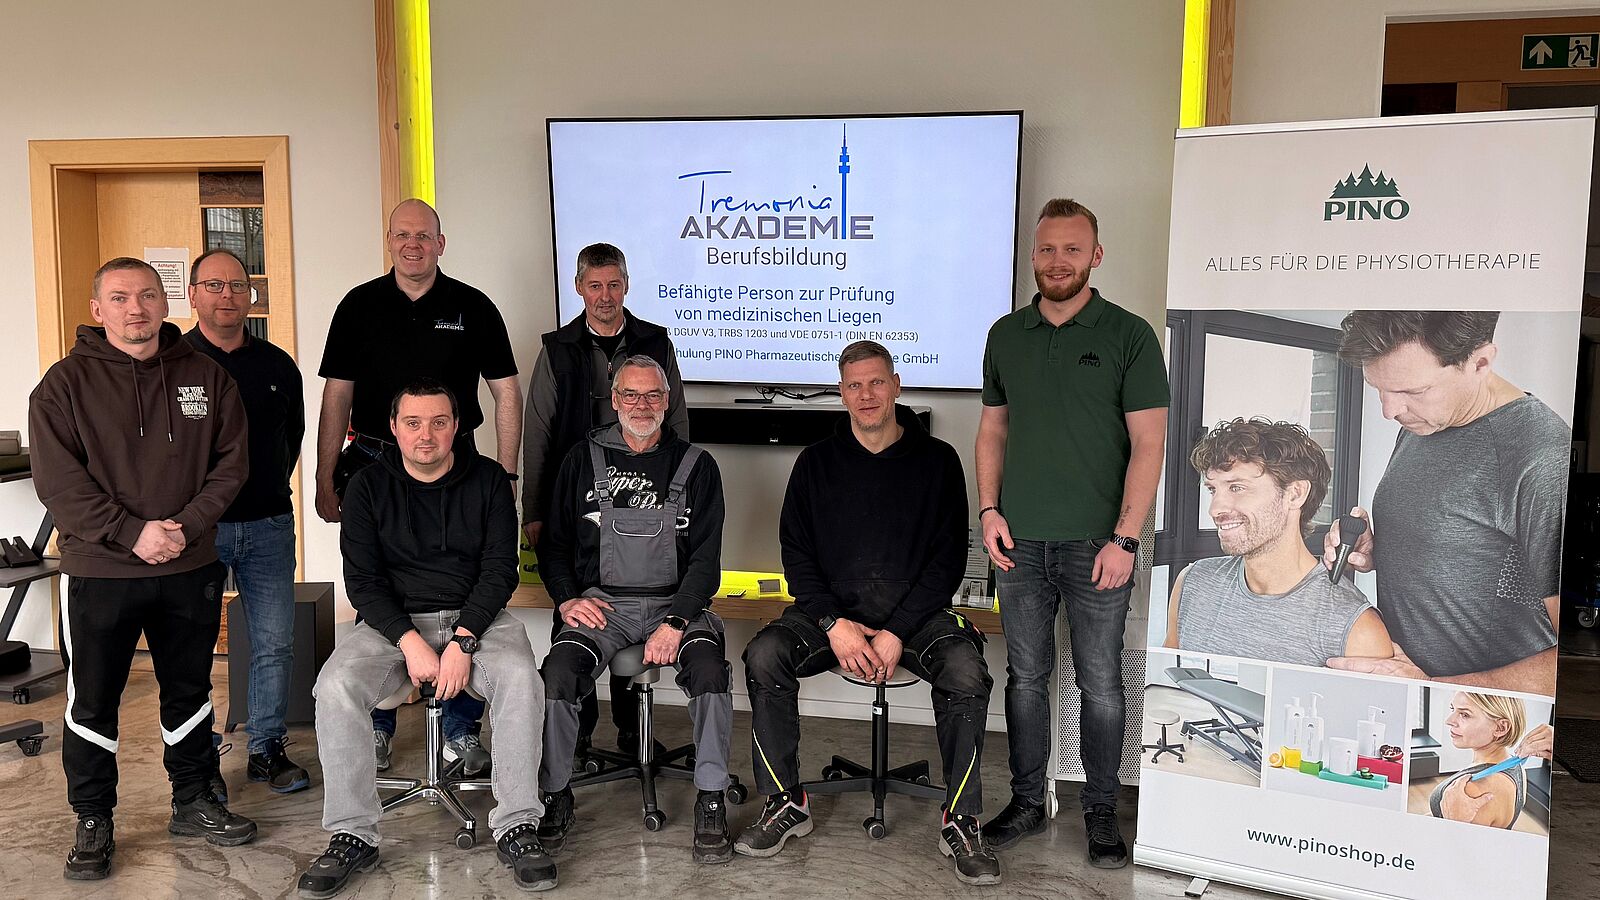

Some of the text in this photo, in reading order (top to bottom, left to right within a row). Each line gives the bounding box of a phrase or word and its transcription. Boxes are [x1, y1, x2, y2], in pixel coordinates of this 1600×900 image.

[678, 170, 832, 214] Tremonia
[1323, 198, 1410, 222] PINO
[680, 215, 874, 240] AKADEMIE
[707, 246, 847, 271] Berufsbildung
[1205, 251, 1541, 272] ALLES FÜR DIE PHYSIOTHERAPIE
[658, 284, 895, 305] Befähigte Person zur Prüfung
[674, 306, 882, 327] von medizinischen Liegen
[674, 327, 700, 337] DGUV
[702, 328, 717, 338] V3,
[718, 328, 743, 337] TRBS
[746, 329, 768, 338] 1203
[770, 329, 788, 339] und
[789, 330, 809, 339] VDE
[811, 330, 843, 340] 0751-1
[845, 331, 867, 341] (DIN
[869, 331, 883, 340] EN
[885, 331, 919, 343] 62353)
[714, 348, 743, 360] PINO
[745, 349, 840, 363] Pharmazeutische
[902, 353, 939, 364] GmbH
[1078, 359, 1101, 368] PINO
[1247, 828, 1416, 871] www.pinoshop.de
